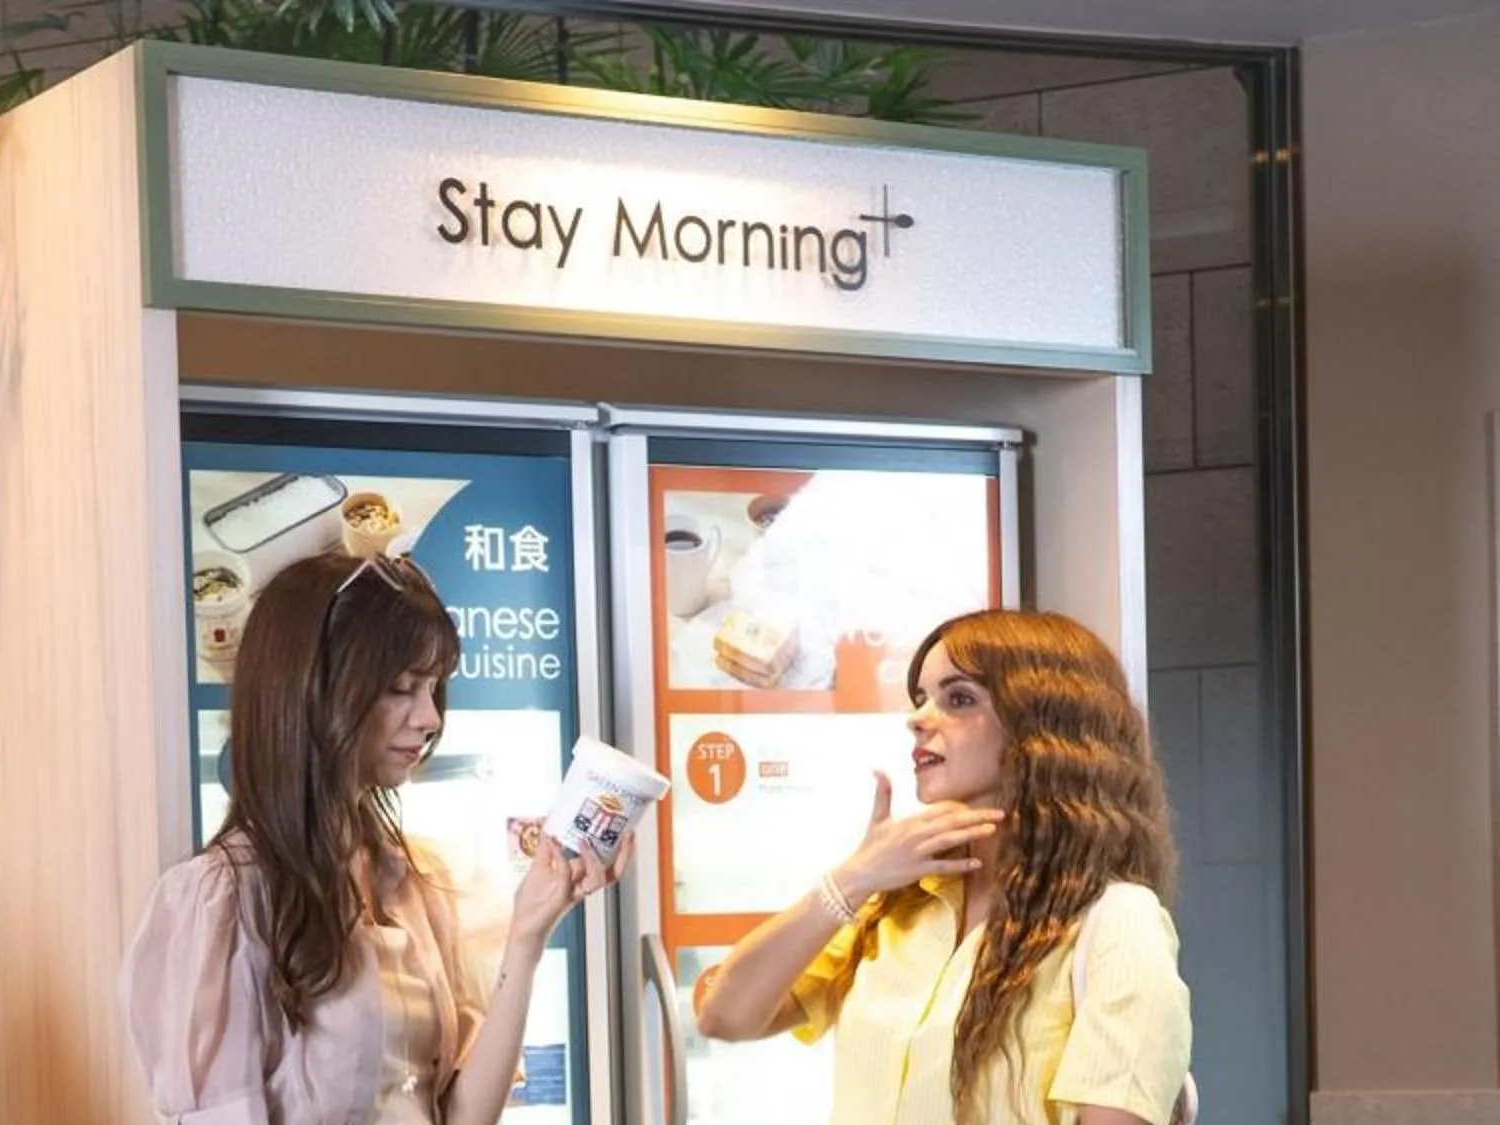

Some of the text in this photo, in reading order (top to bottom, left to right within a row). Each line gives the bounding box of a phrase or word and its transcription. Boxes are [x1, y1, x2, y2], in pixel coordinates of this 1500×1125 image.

[437, 177, 583, 269] Stay
[463, 523, 550, 572] 和食
[445, 605, 561, 640] anese
[451, 645, 562, 681] uisine
[697, 743, 736, 760] STEP
[708, 764, 722, 797] 1
